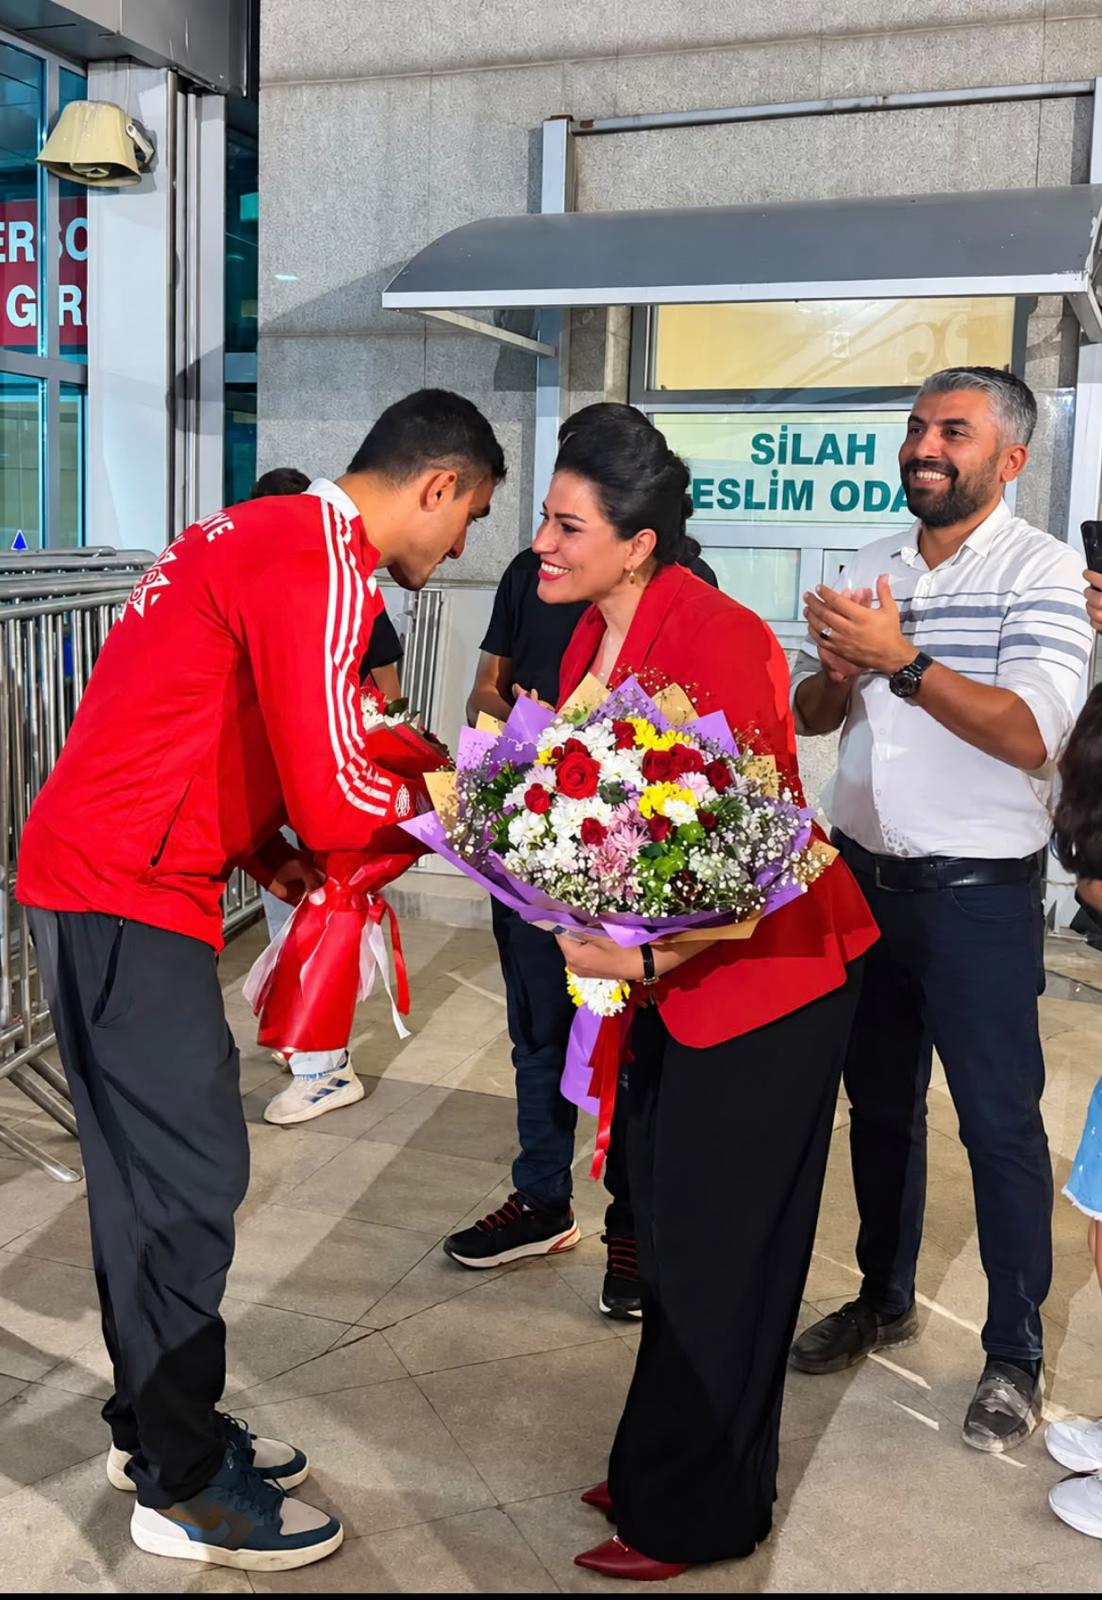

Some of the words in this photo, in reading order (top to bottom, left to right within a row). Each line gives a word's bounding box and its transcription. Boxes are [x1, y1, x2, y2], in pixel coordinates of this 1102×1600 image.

[0, 217, 88, 262] RO
[6, 284, 88, 328] GR
[750, 424, 877, 466] SİLAH
[691, 469, 814, 512] ESLİM
